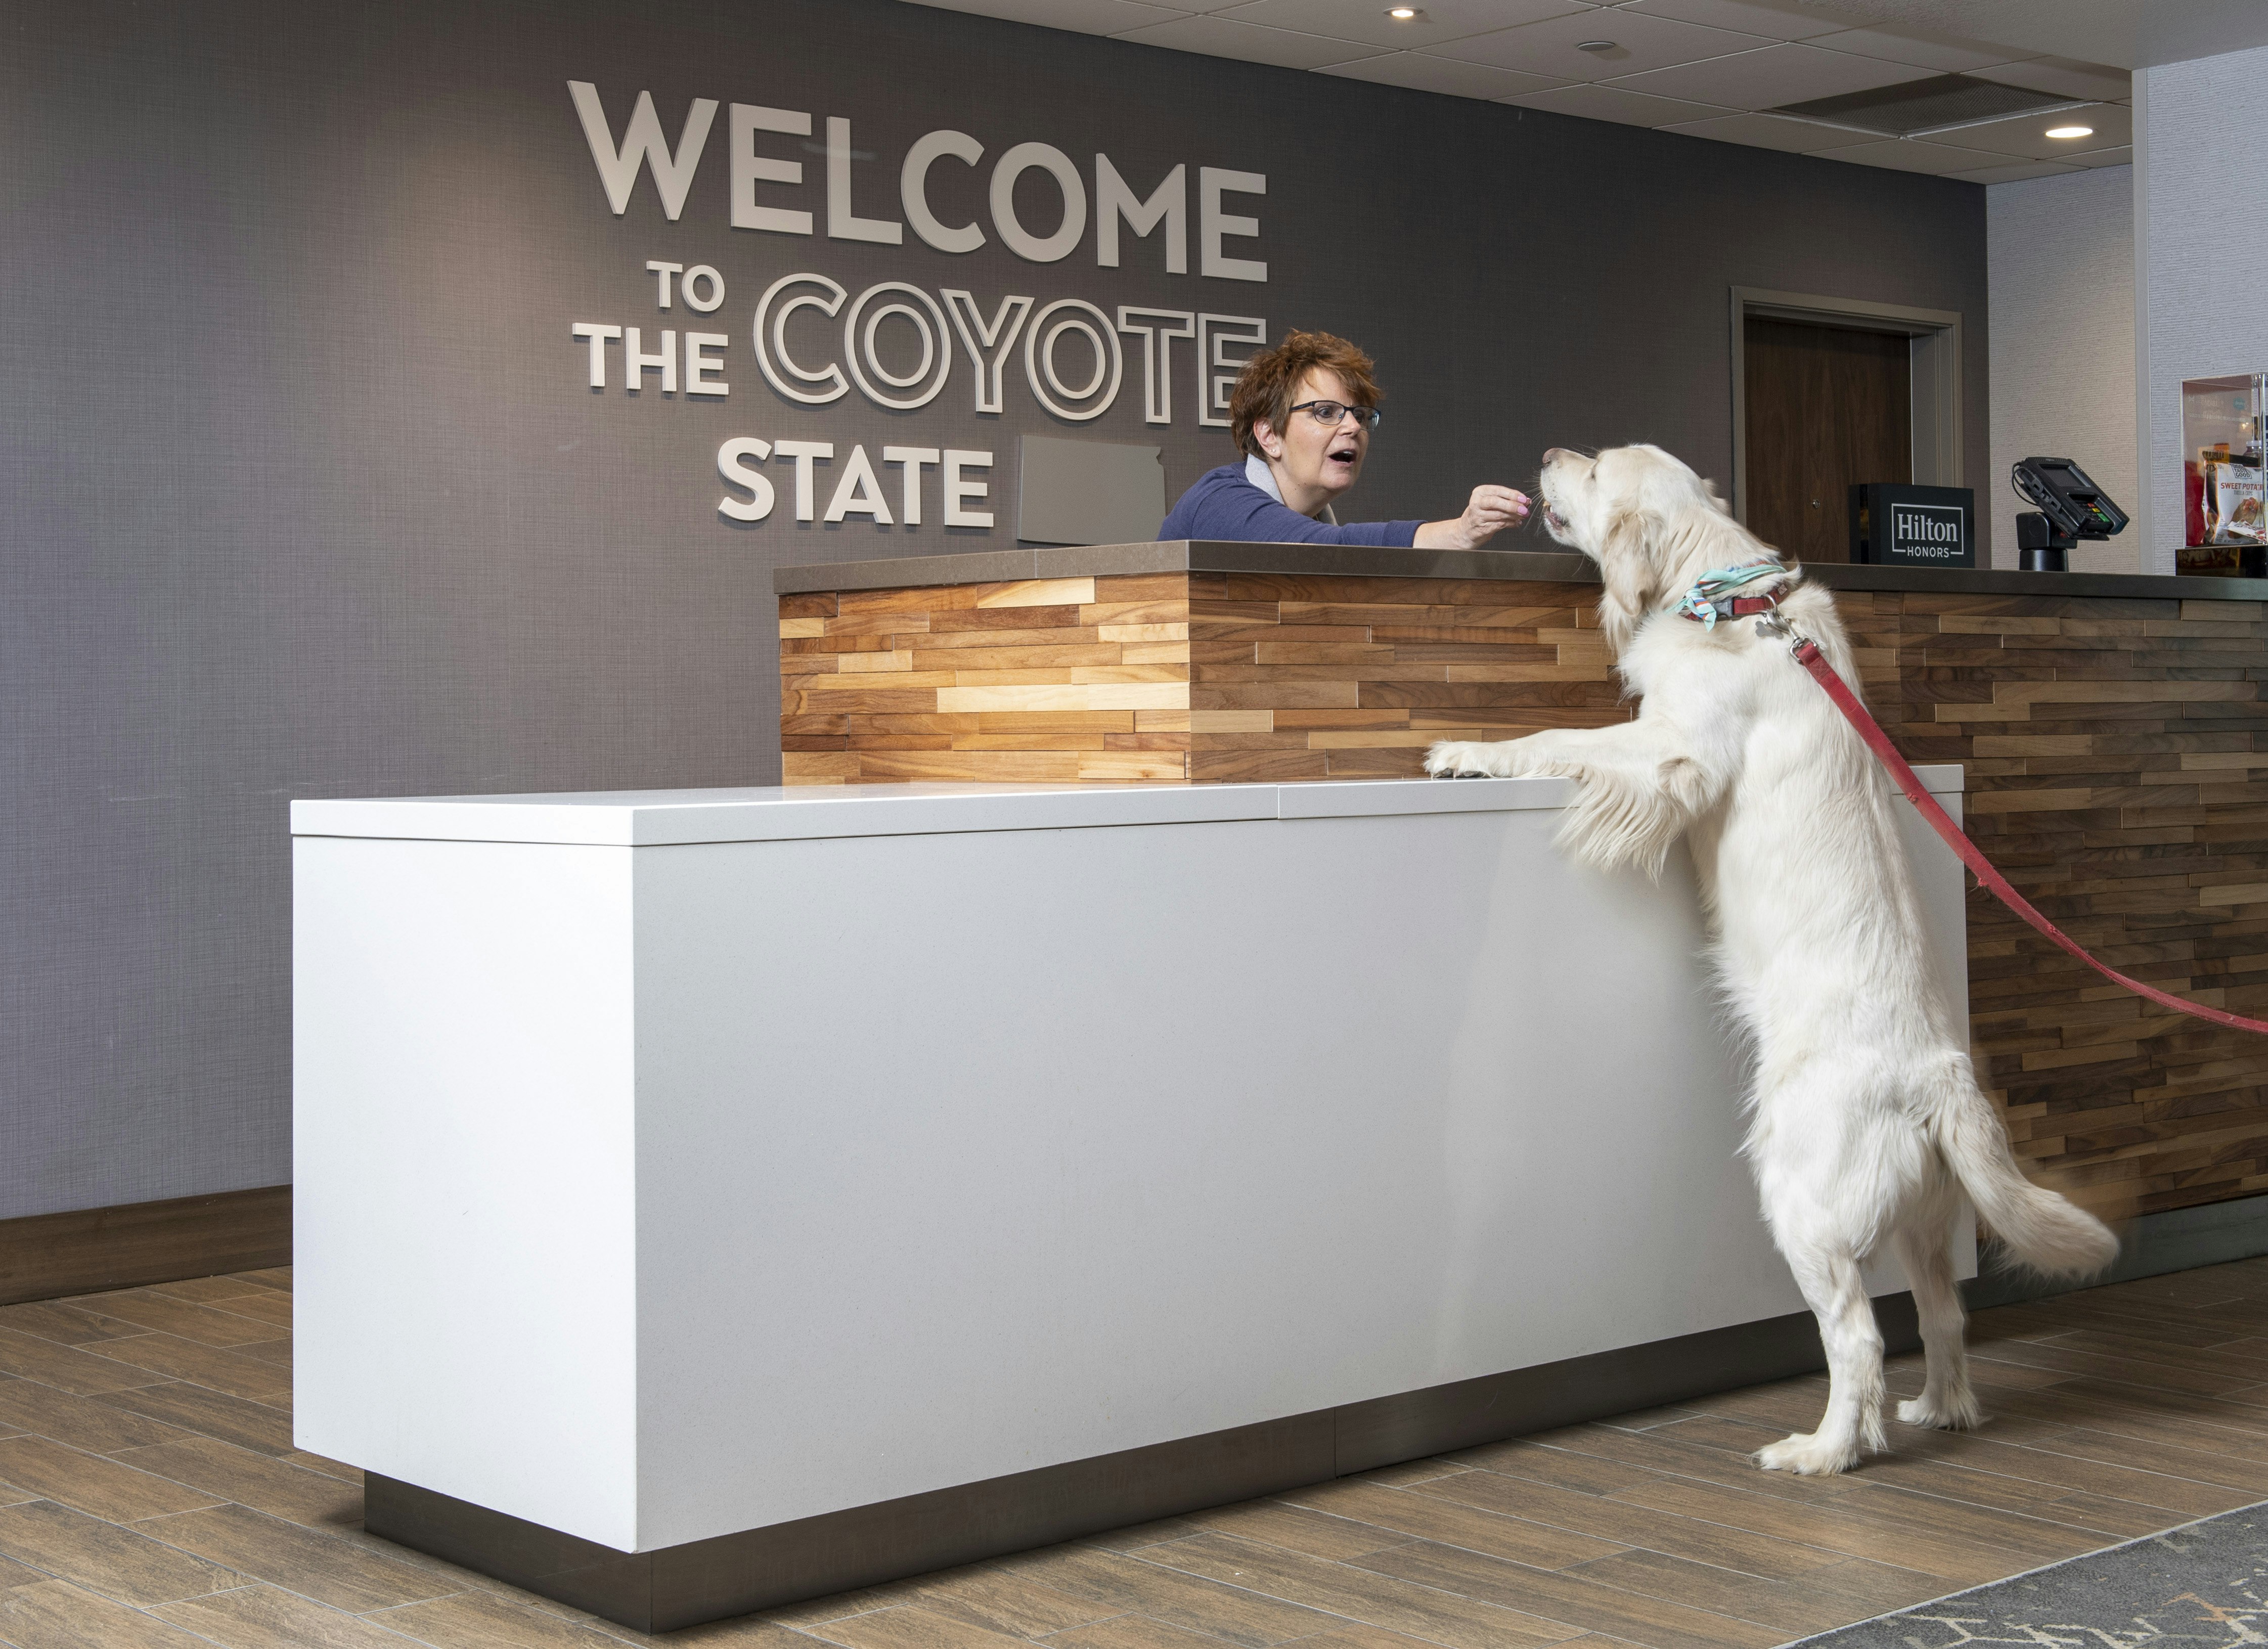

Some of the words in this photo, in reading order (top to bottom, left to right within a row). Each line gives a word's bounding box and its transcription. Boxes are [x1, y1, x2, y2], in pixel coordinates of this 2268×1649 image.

[567, 80, 1267, 282] WELCOME
[646, 260, 726, 312] TO
[572, 322, 729, 395] THE
[753, 273, 1266, 427] COYOTE
[717, 436, 994, 527] STATE
[1898, 514, 1958, 542] Hilton
[1907, 546, 1949, 558] HONORS
